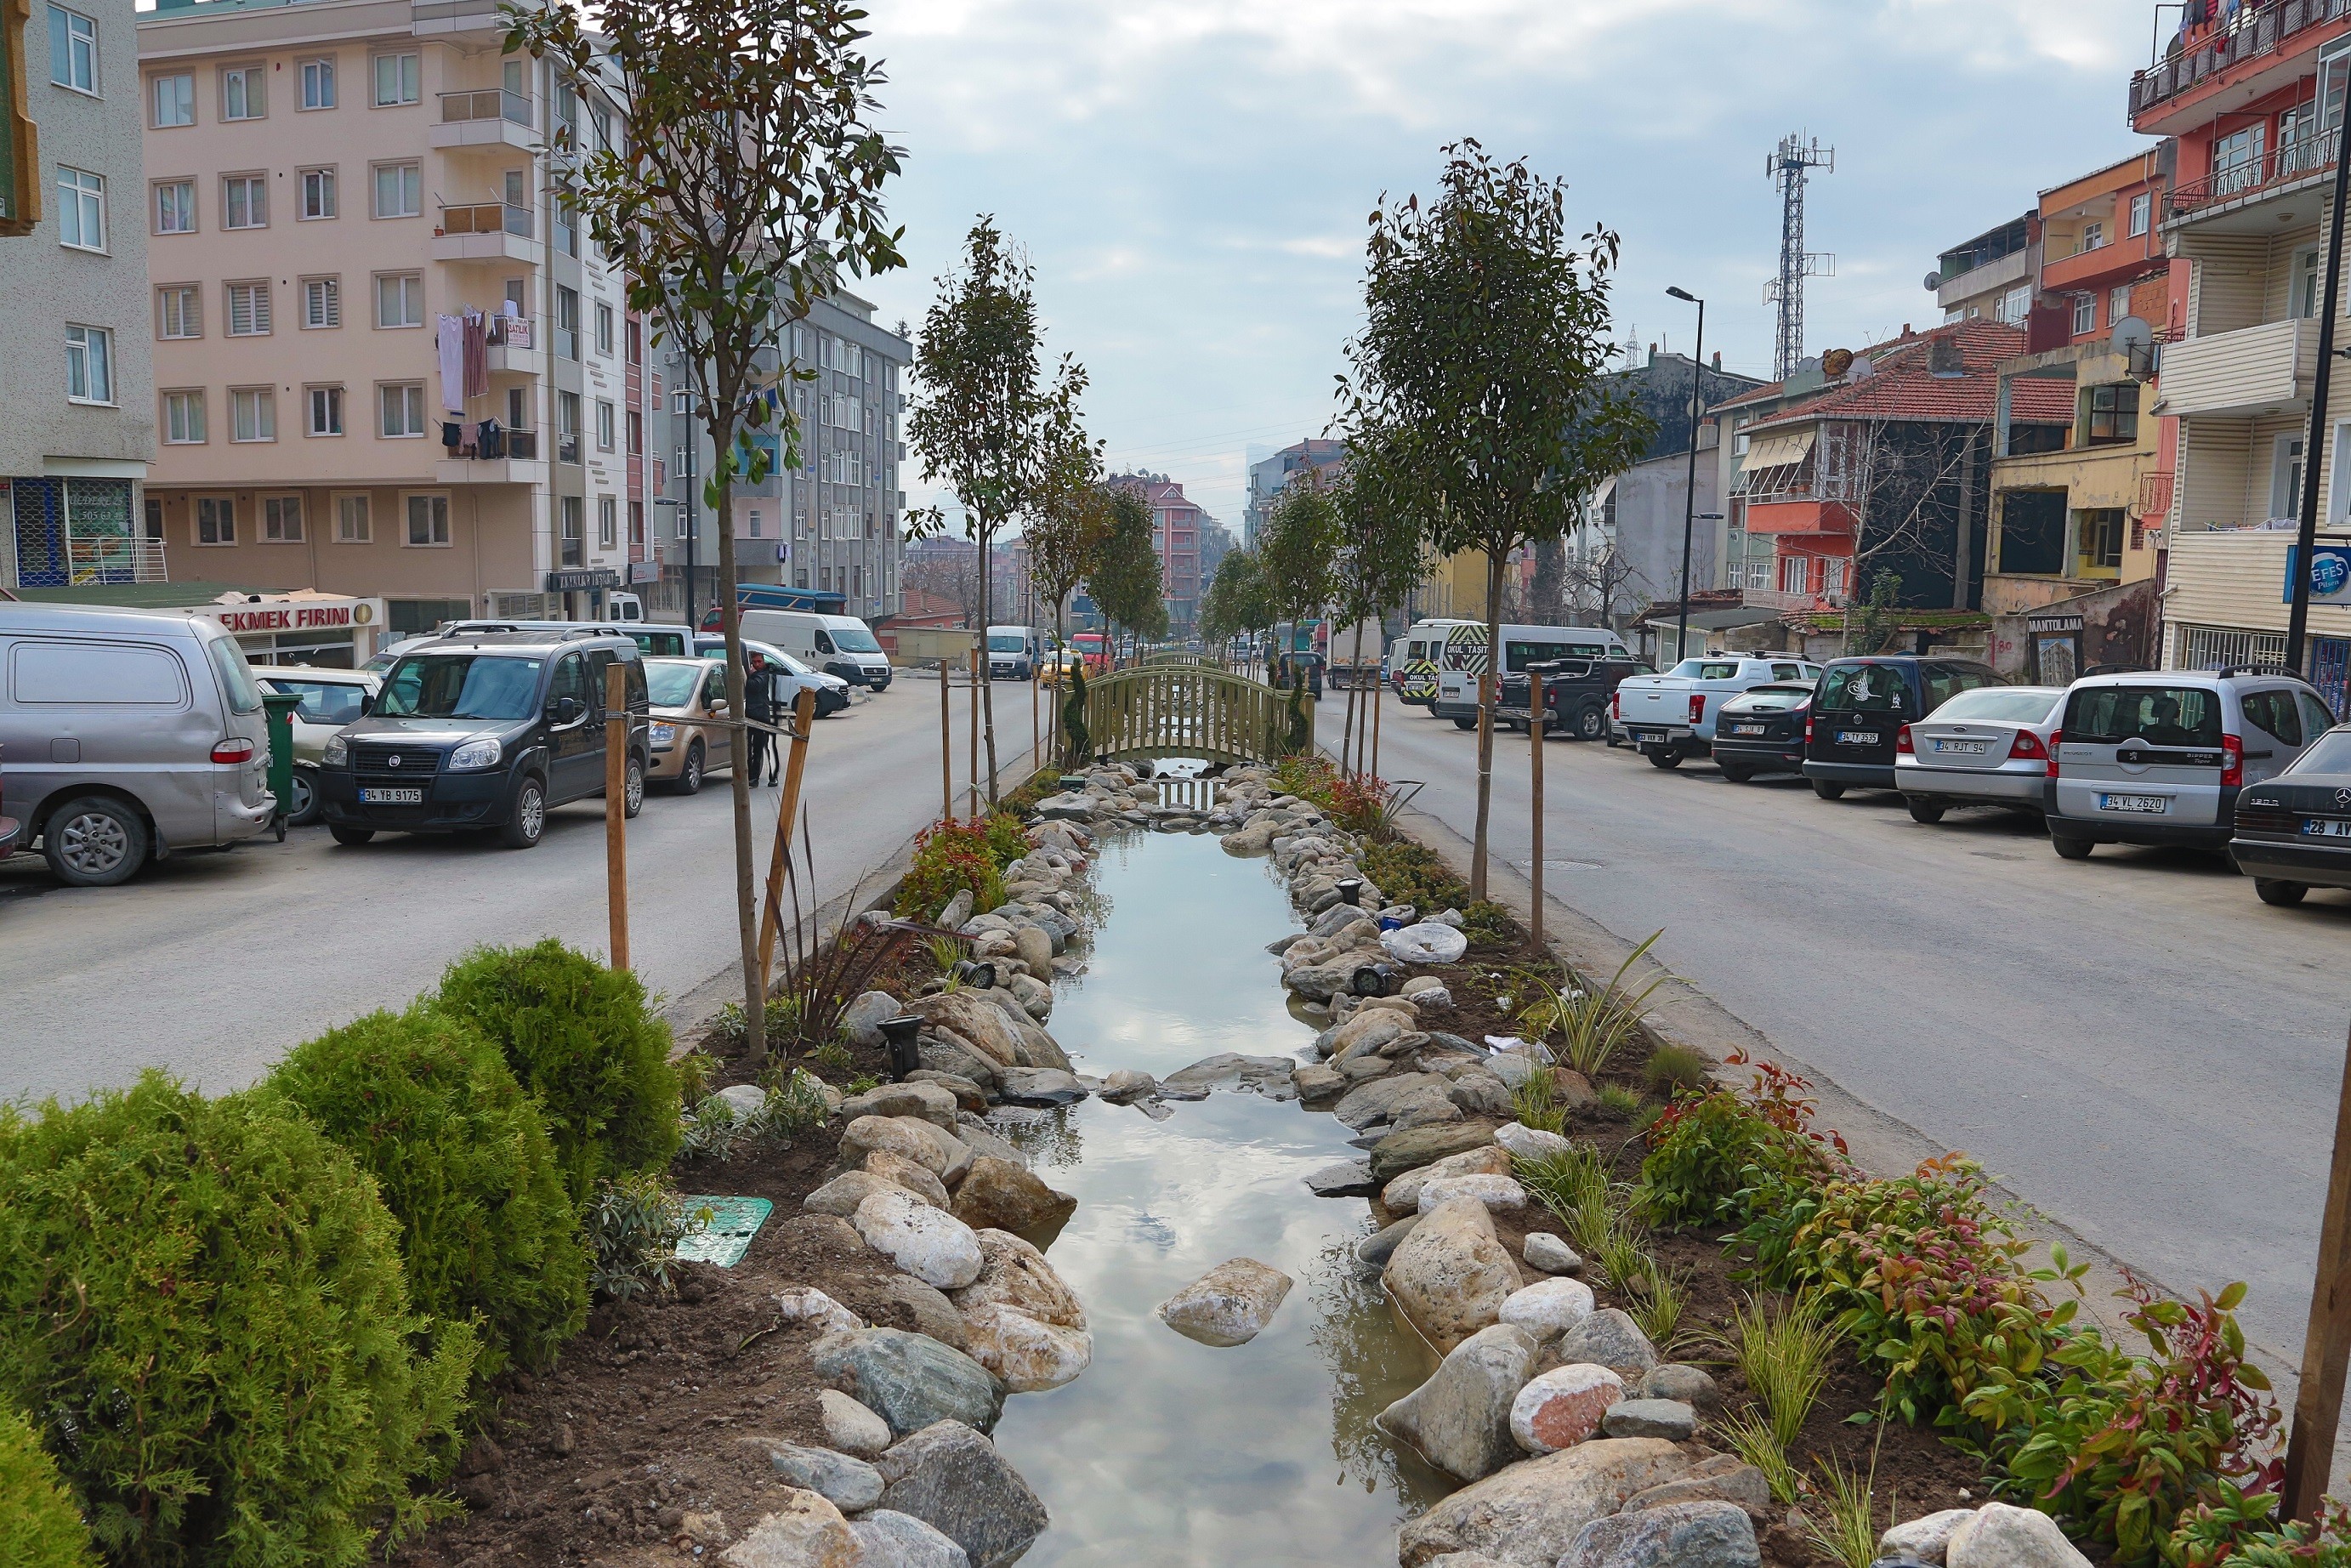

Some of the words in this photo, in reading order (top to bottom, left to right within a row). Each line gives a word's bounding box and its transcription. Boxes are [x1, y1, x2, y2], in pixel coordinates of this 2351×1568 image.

[2311, 564, 2343, 582] EFES
[2318, 580, 2339, 590] Pilsen
[219, 610, 292, 632] EKMEK
[295, 607, 349, 628] FIRINI
[2029, 618, 2083, 632] MANTOLAMA
[1468, 646, 1489, 655] TAŞIT
[1842, 732, 1850, 741] 34
[1939, 741, 1949, 750] 34
[1954, 742, 1968, 751] RJT
[1973, 743, 1983, 752] 94
[365, 790, 377, 800] 34
[380, 790, 392, 800] YB
[395, 790, 420, 801] 9175
[2107, 796, 2118, 806] 34
[2122, 797, 2133, 807] VL
[2136, 798, 2162, 808] 2620
[2309, 821, 2325, 834] 28
